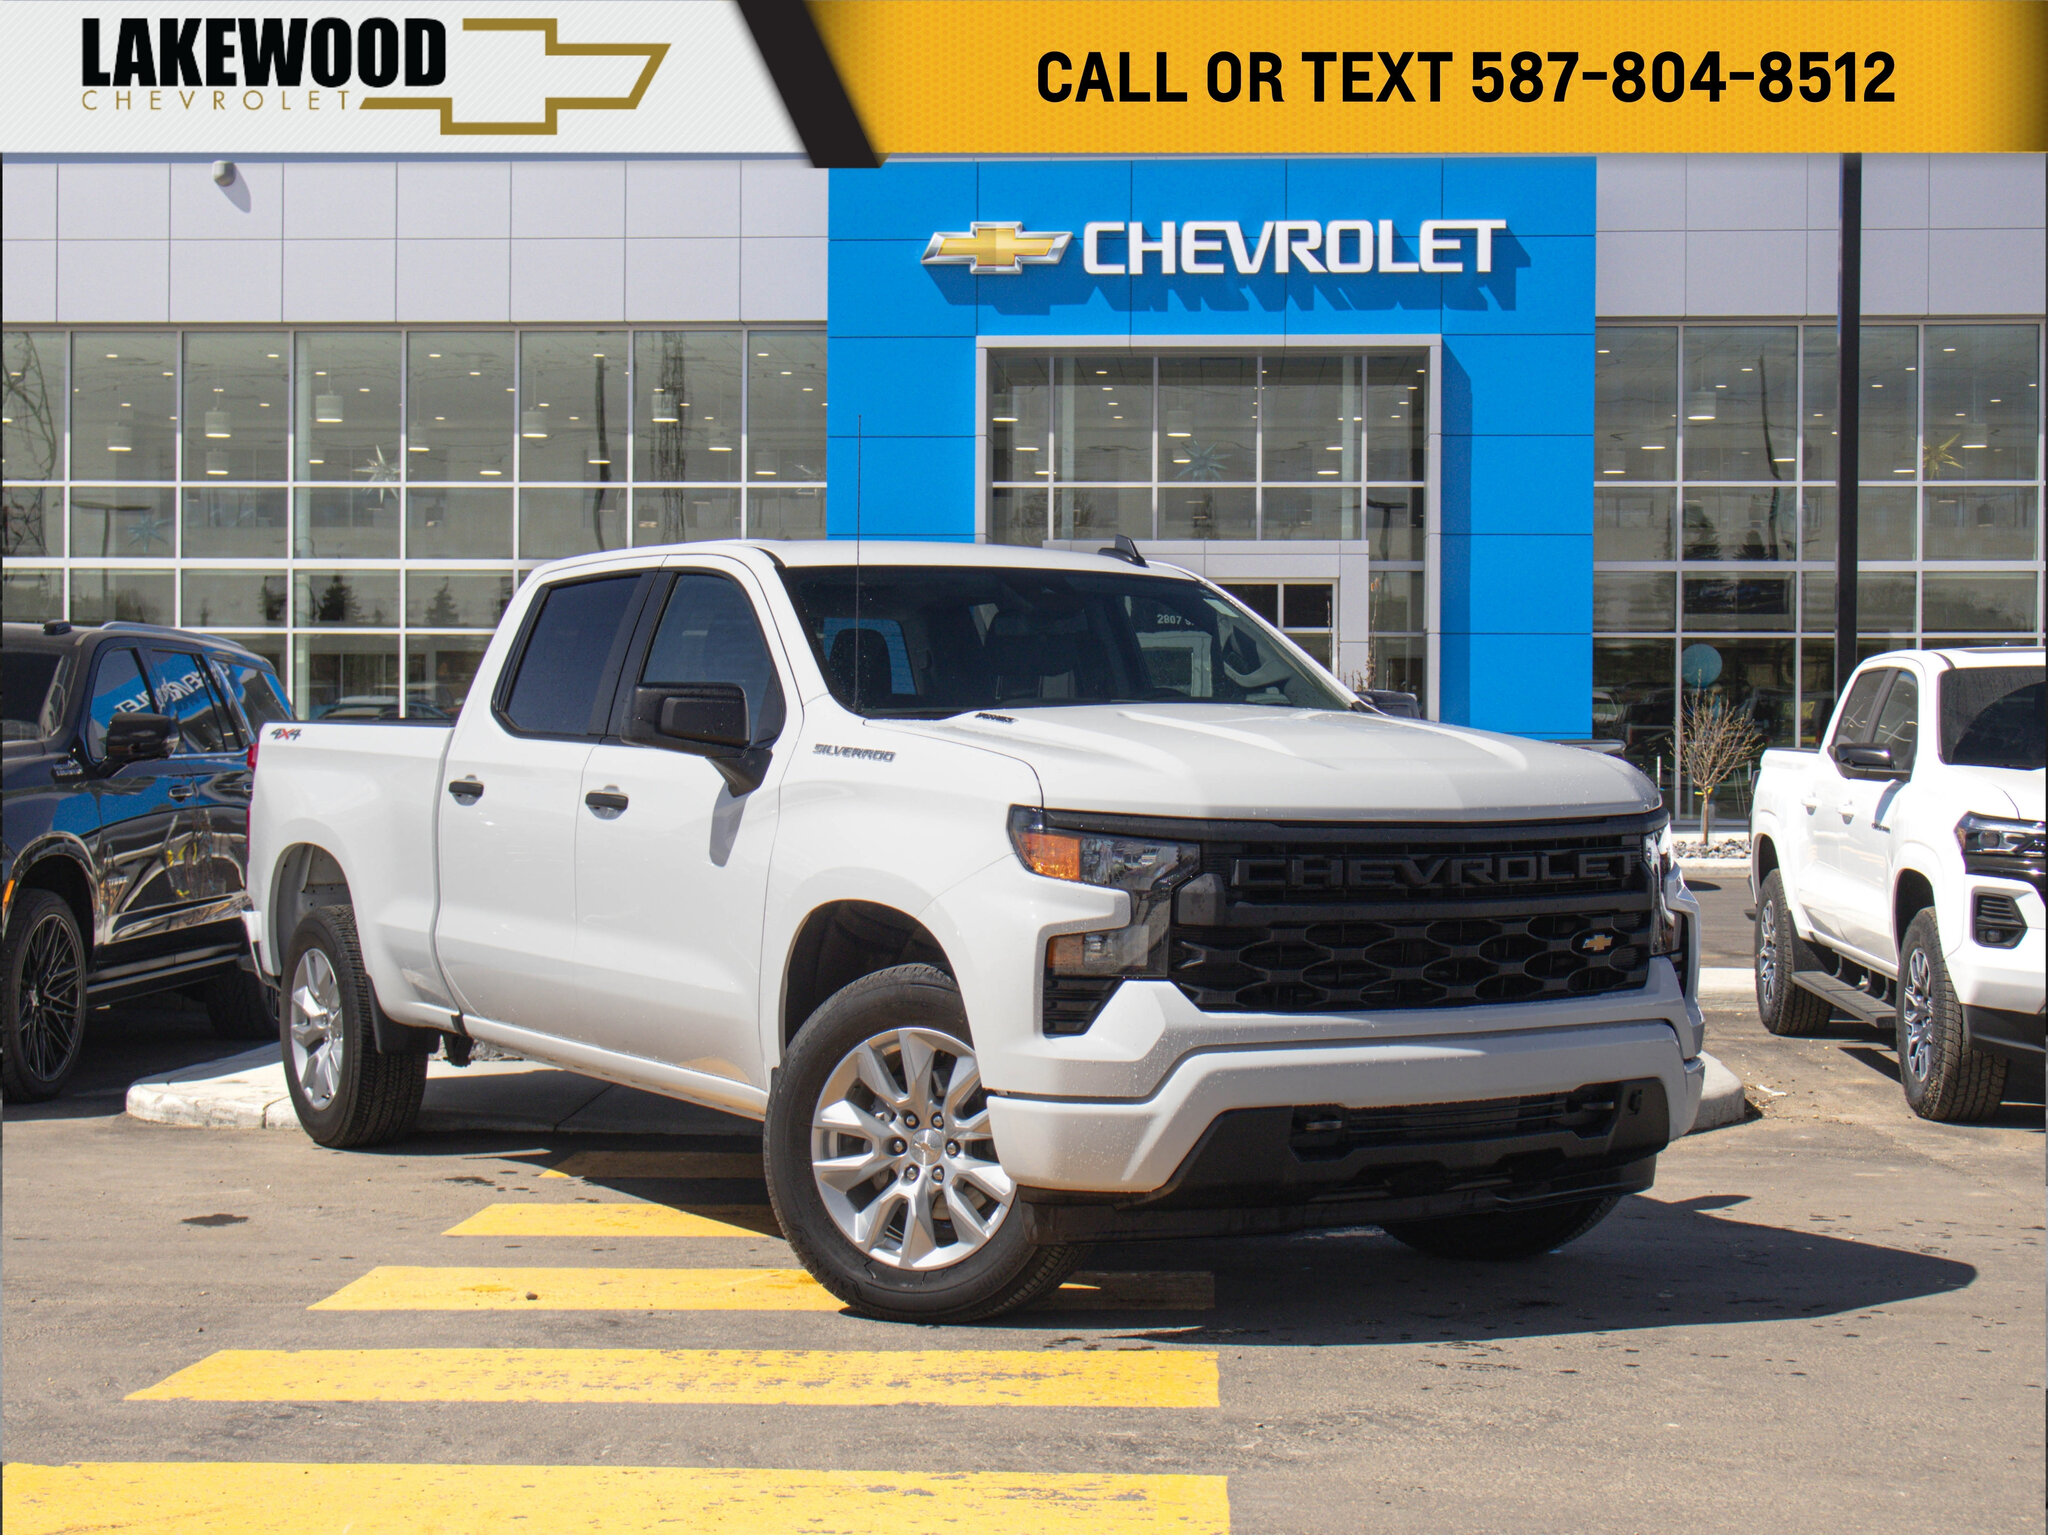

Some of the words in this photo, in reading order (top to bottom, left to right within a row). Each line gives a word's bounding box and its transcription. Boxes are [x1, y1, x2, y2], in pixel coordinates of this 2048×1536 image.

[1083, 219, 1507, 275] CHEVROLET
[813, 743, 896, 763] SILVERADO
[1231, 851, 1641, 888] CHEVROLET
